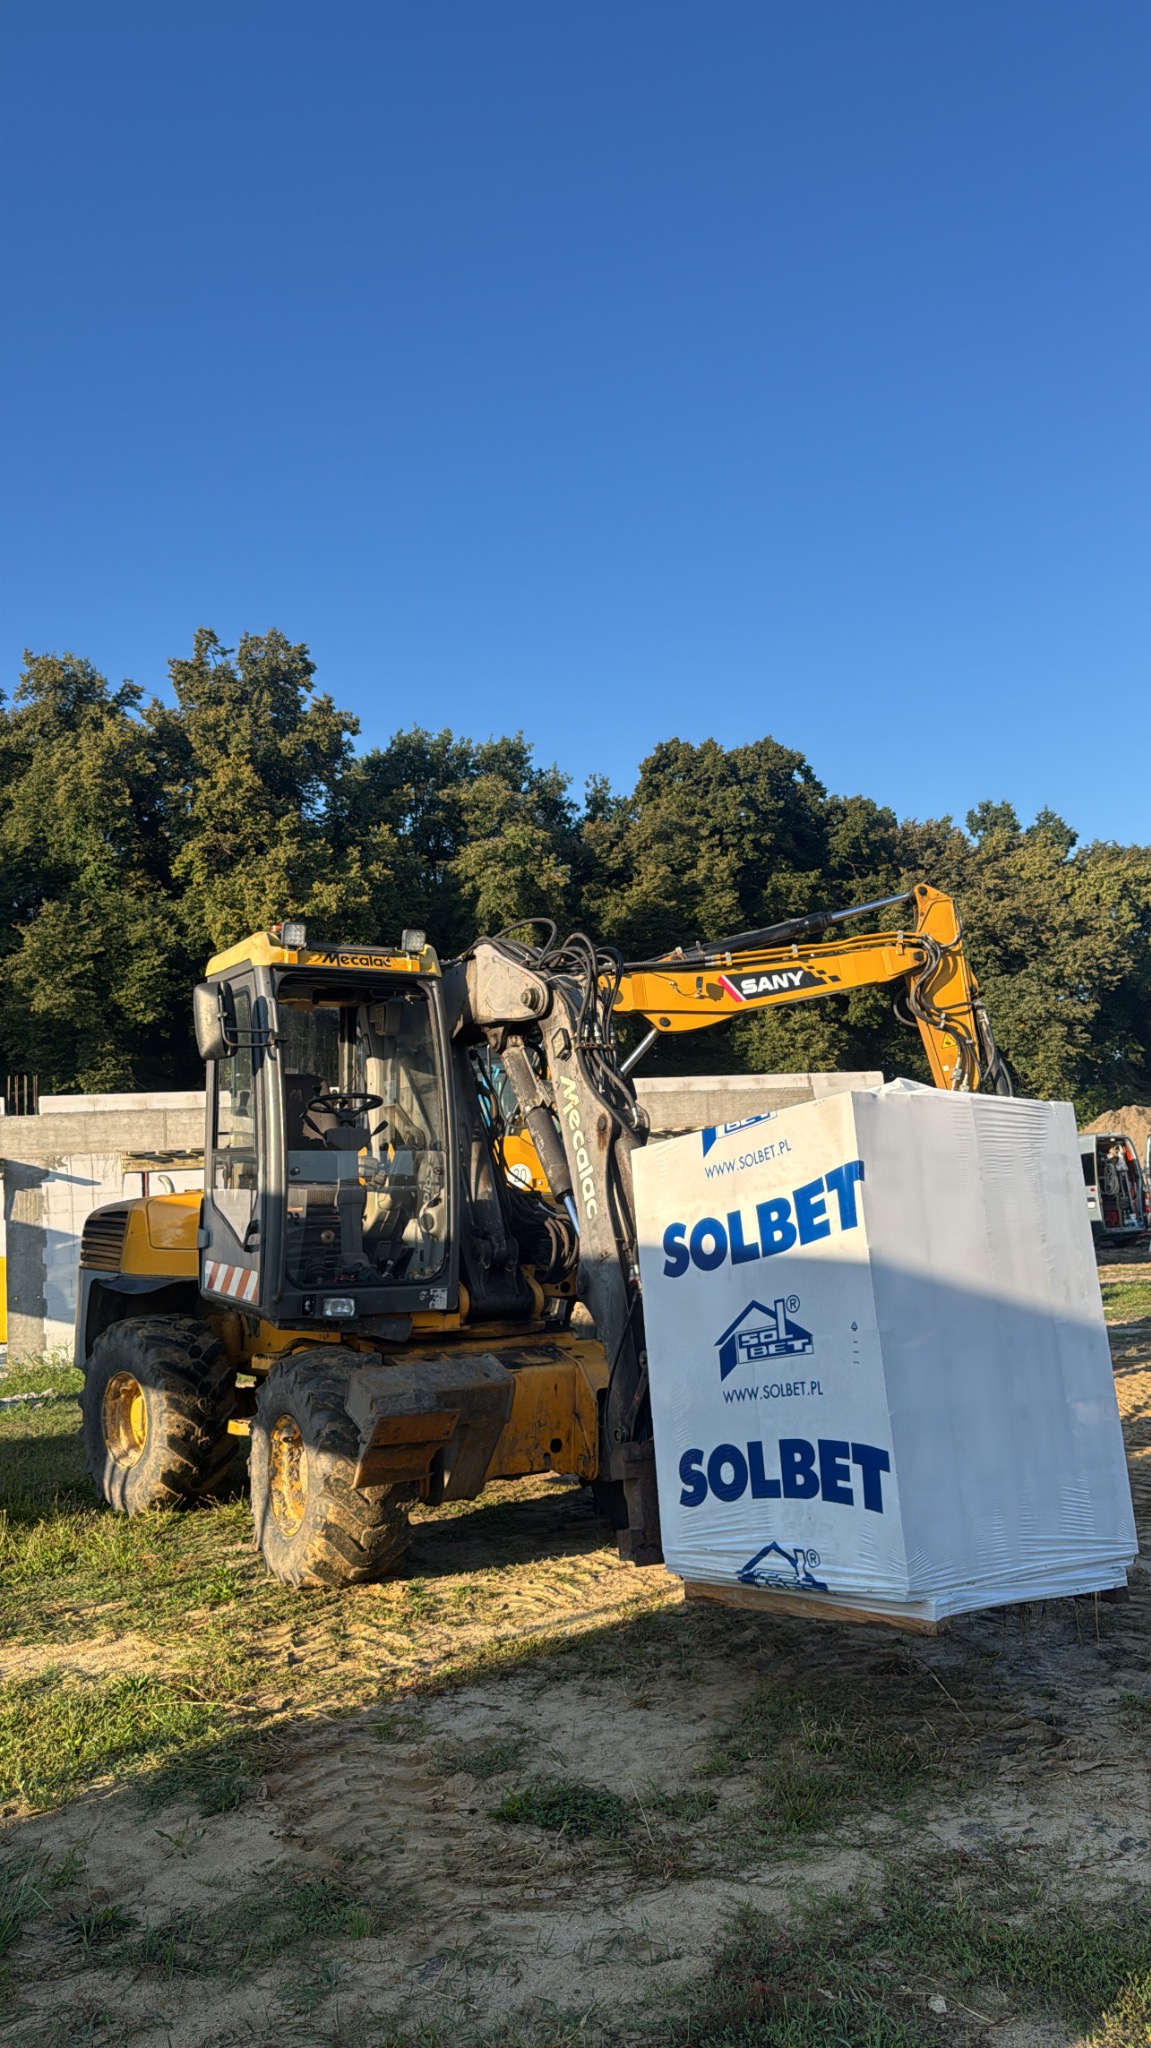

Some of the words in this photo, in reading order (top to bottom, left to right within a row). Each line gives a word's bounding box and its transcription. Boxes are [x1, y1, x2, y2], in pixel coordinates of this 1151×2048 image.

[322, 953, 392, 968] Mecalac
[740, 970, 804, 995] SANY
[560, 1075, 599, 1220] Mecalac
[704, 1139, 792, 1179] WWW.SOLBET.PL
[663, 1160, 865, 1278] SOLBET
[750, 1339, 809, 1358] BET
[723, 1381, 824, 1404] WWW.SOLBET.PL
[679, 1438, 891, 1514] SOLBET
